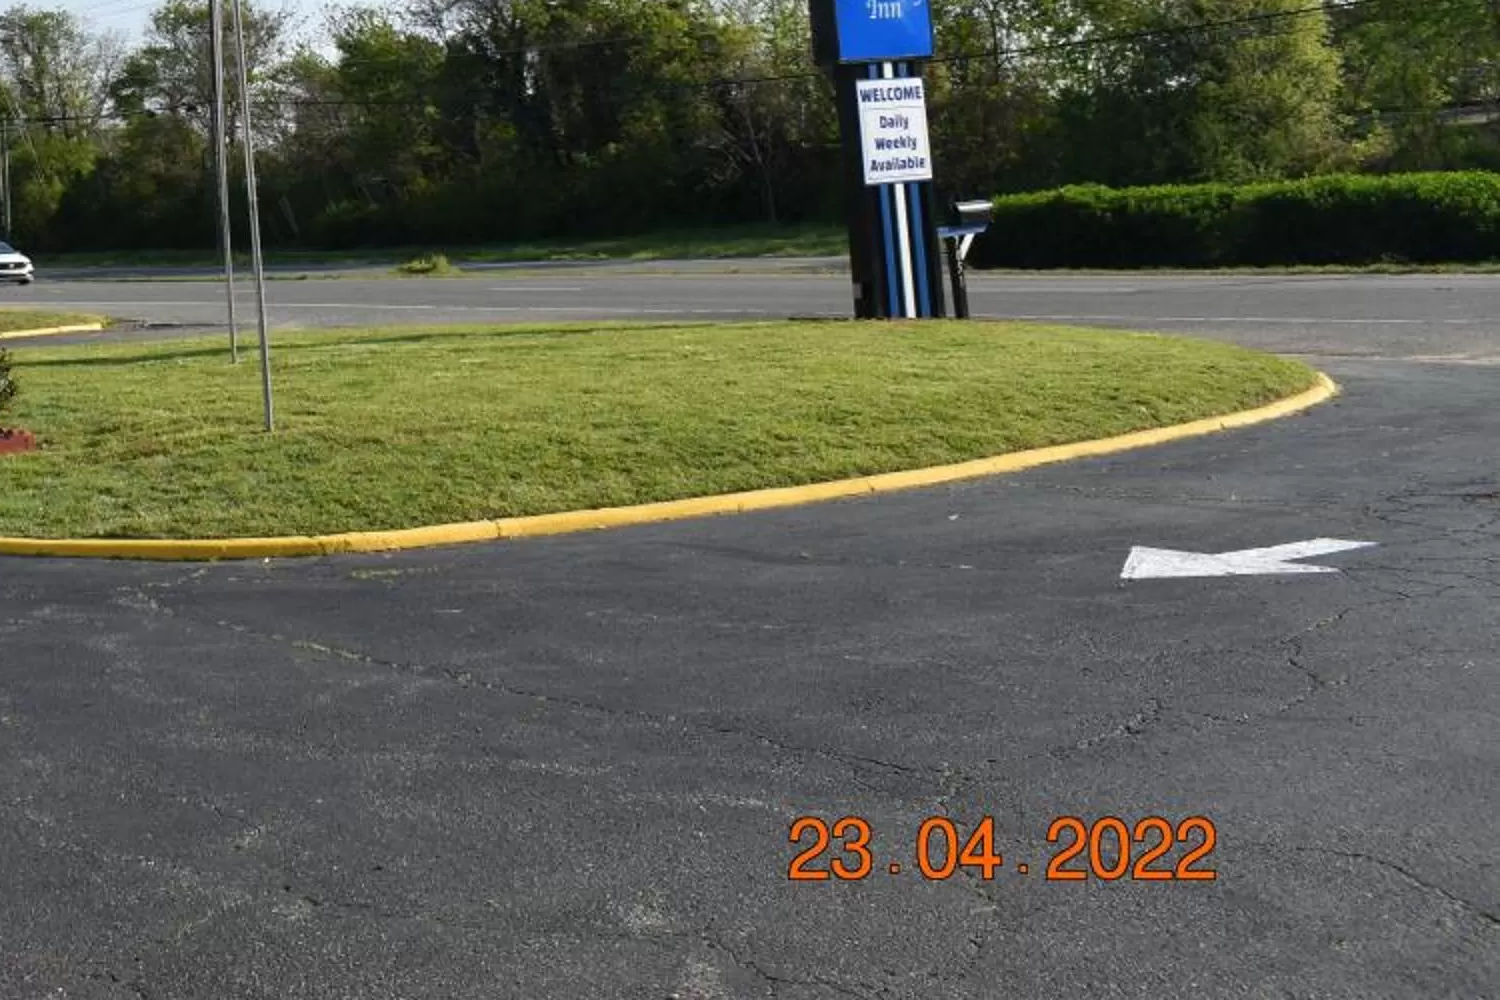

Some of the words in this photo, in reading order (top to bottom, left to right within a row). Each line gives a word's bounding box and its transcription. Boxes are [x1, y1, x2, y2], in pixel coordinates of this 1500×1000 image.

[860, 86, 923, 102] WELCOME
[879, 115, 908, 129] Daily
[874, 136, 916, 150] Weekly
[870, 157, 926, 172] Available
